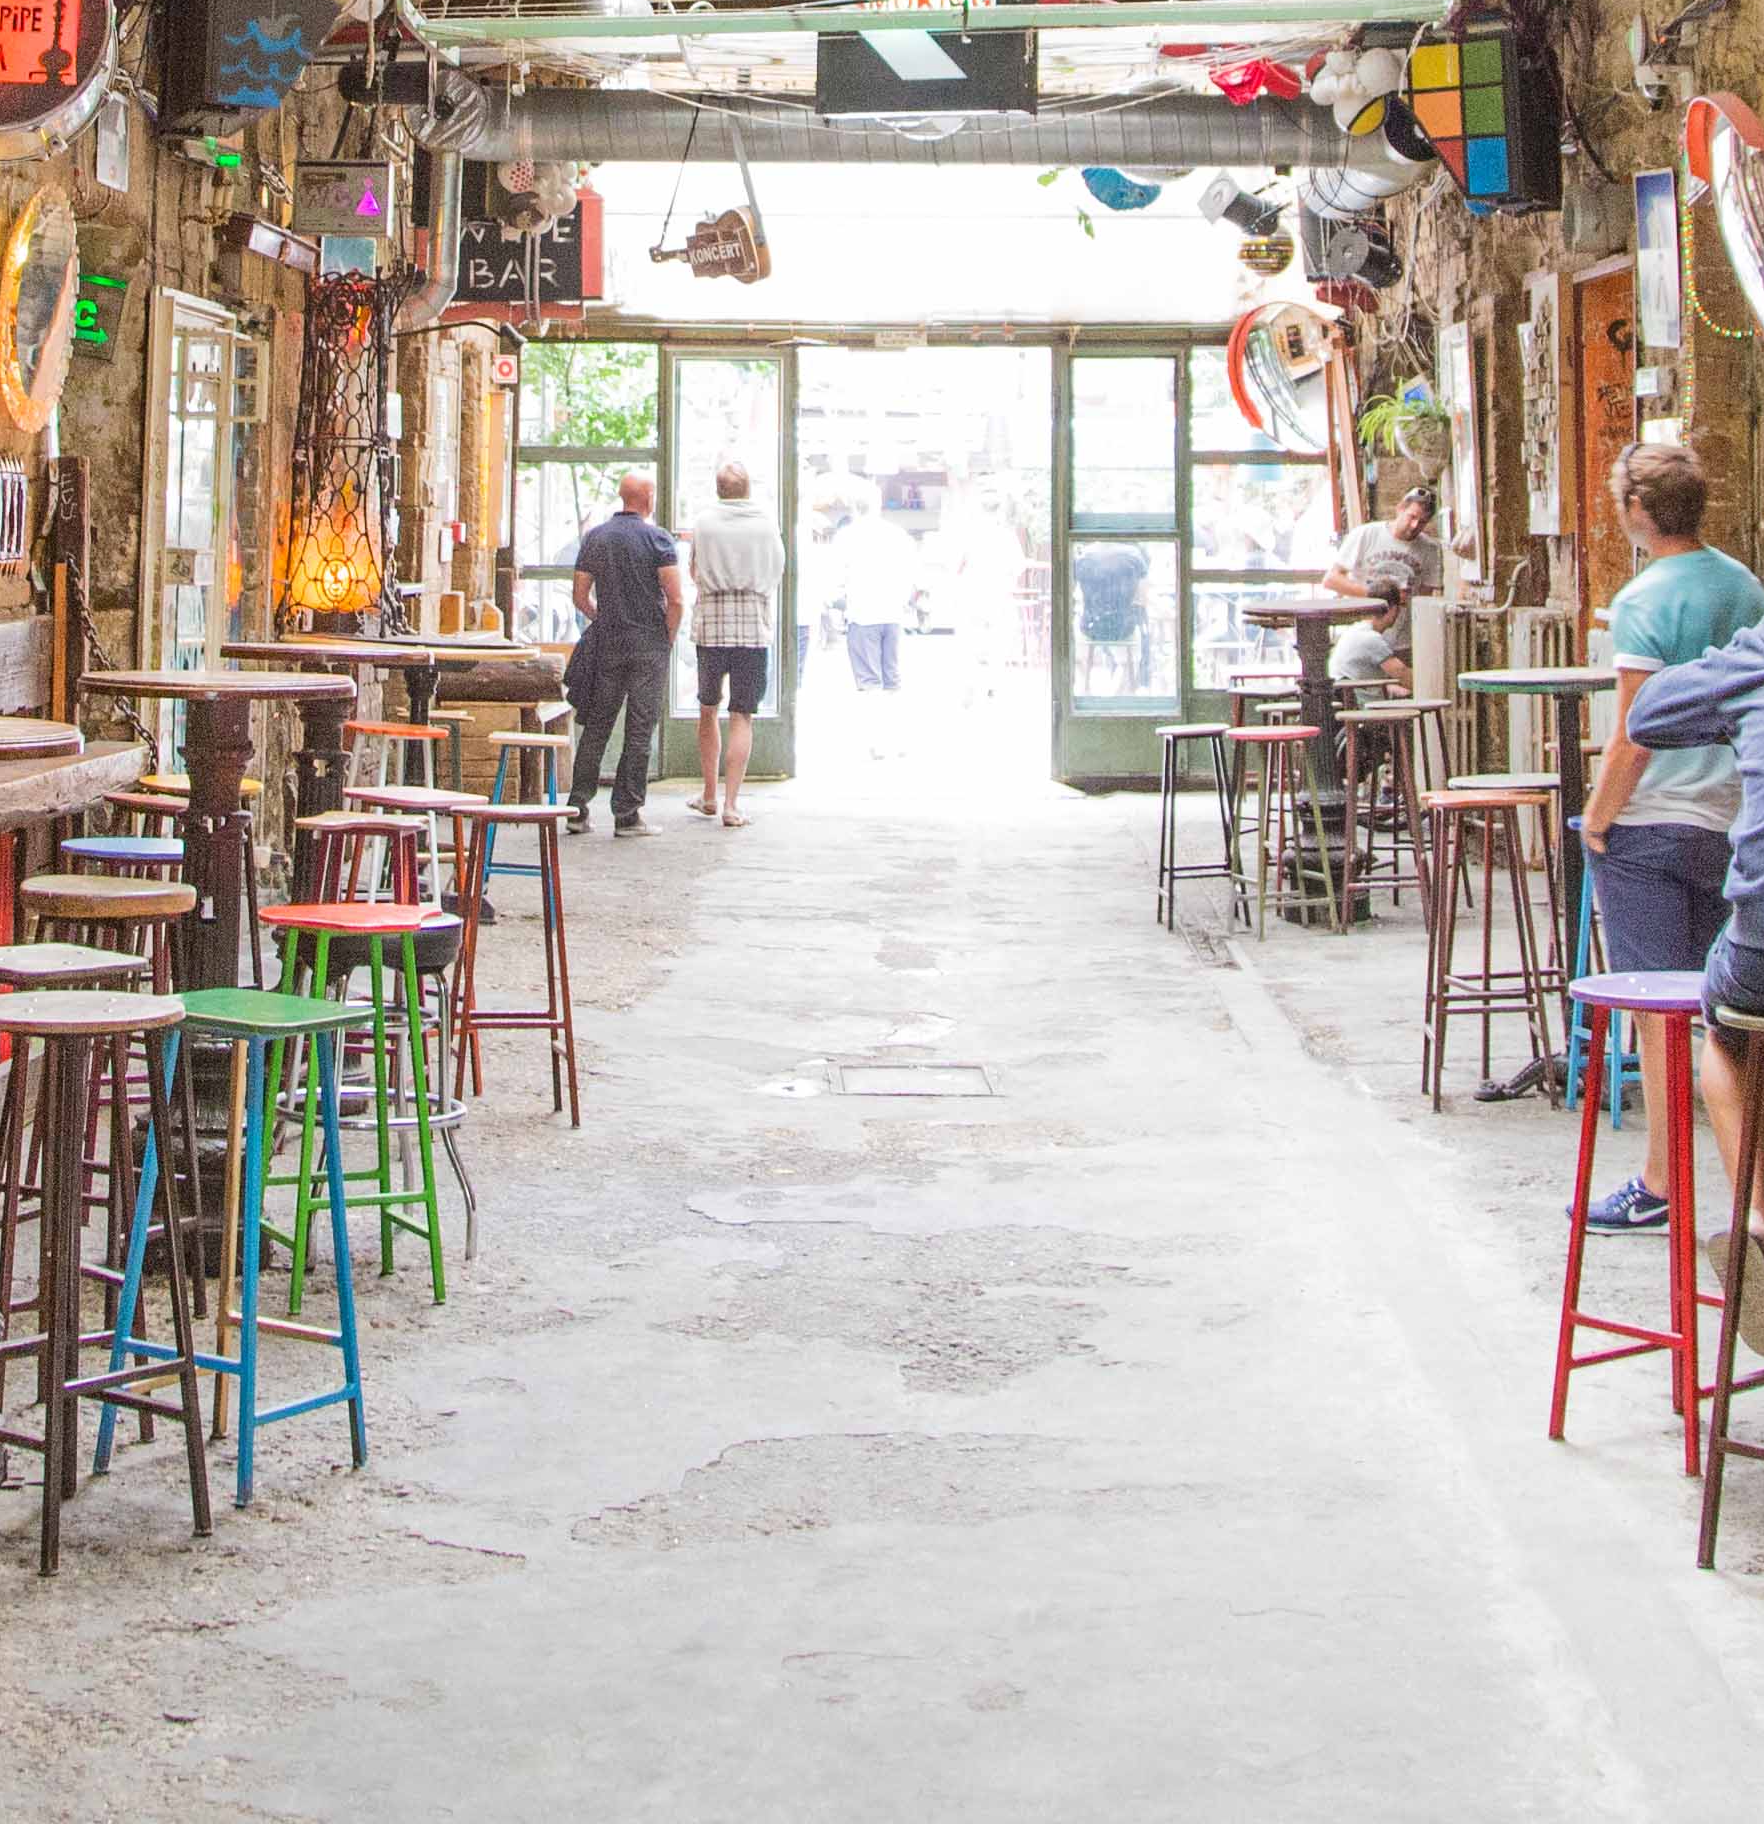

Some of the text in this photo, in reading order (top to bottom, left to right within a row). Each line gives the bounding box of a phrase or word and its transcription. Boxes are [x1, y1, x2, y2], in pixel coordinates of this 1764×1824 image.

[459, 214, 576, 244] WIE
[688, 242, 741, 265] KONCERT
[468, 257, 561, 290] BAR
